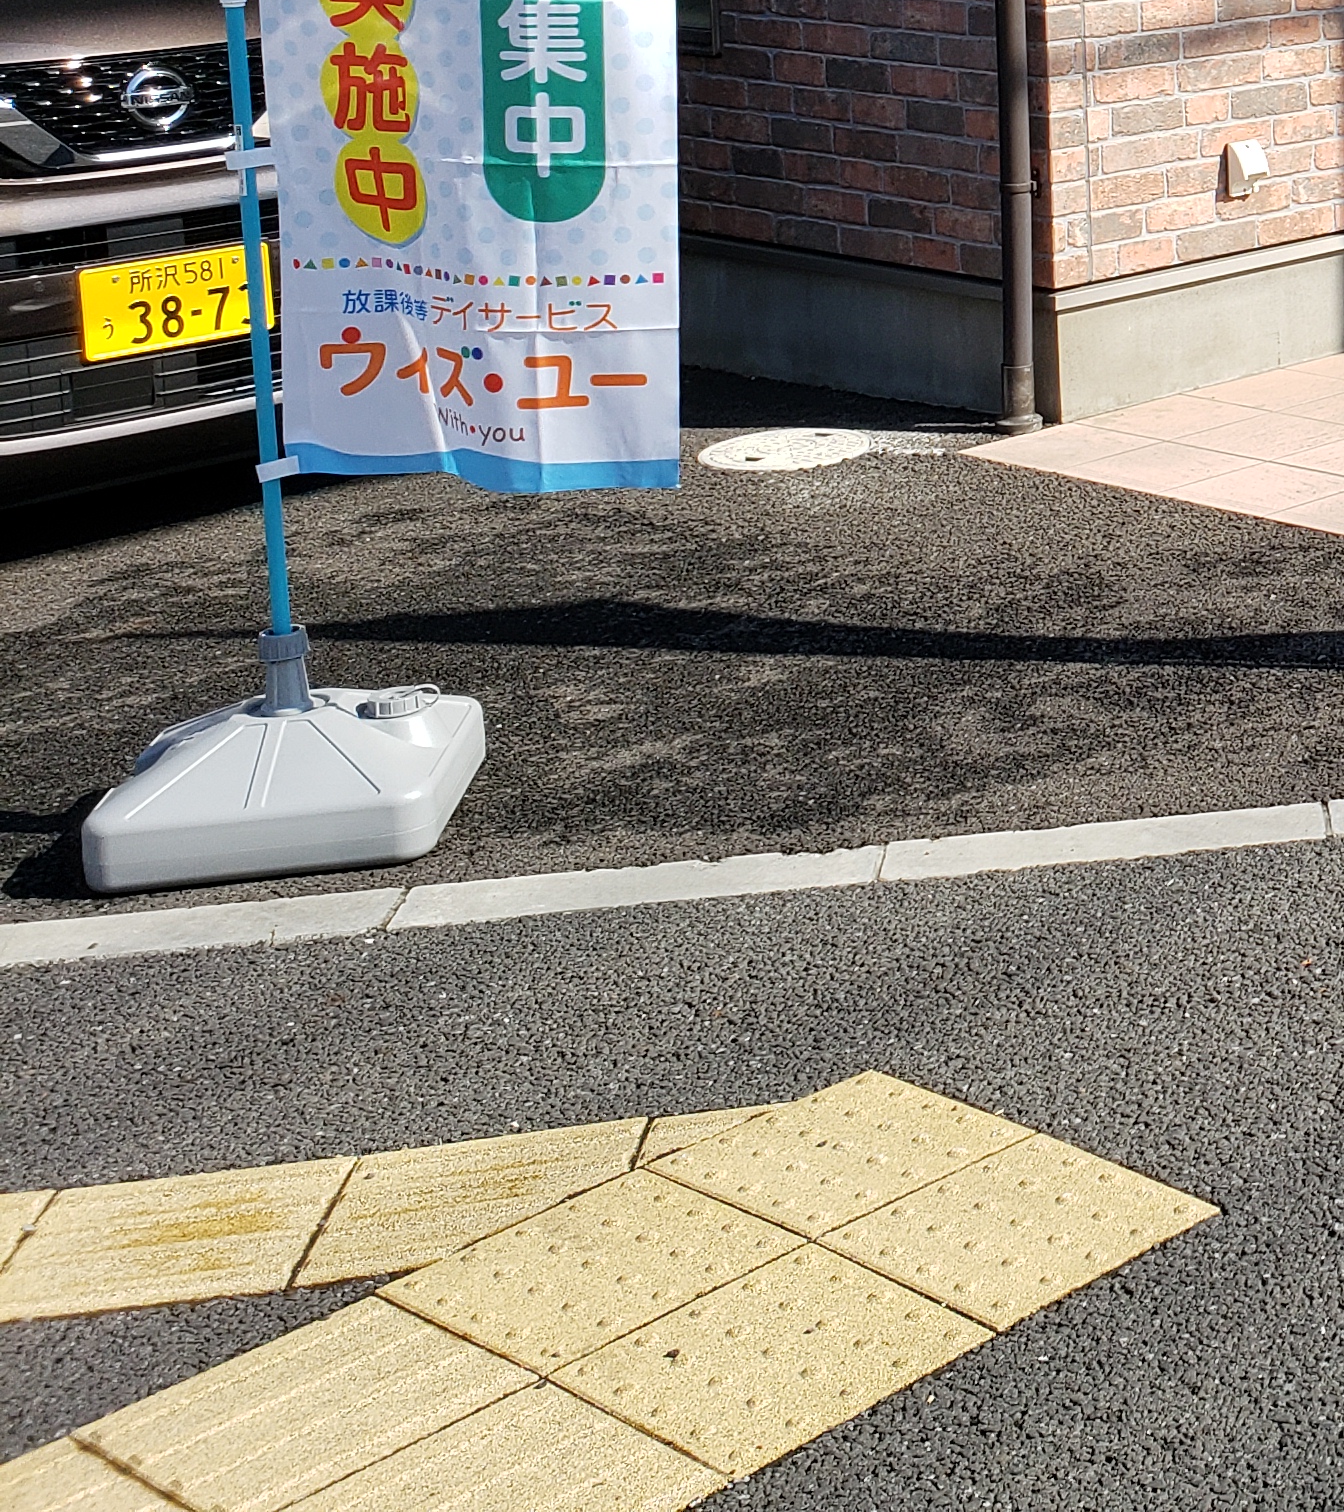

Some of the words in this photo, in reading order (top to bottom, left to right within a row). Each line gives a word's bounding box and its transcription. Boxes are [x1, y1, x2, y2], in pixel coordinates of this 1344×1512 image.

[342, 288, 618, 333] 放課後等デイサービス
[319, 326, 648, 410] ウィズ・ユー
